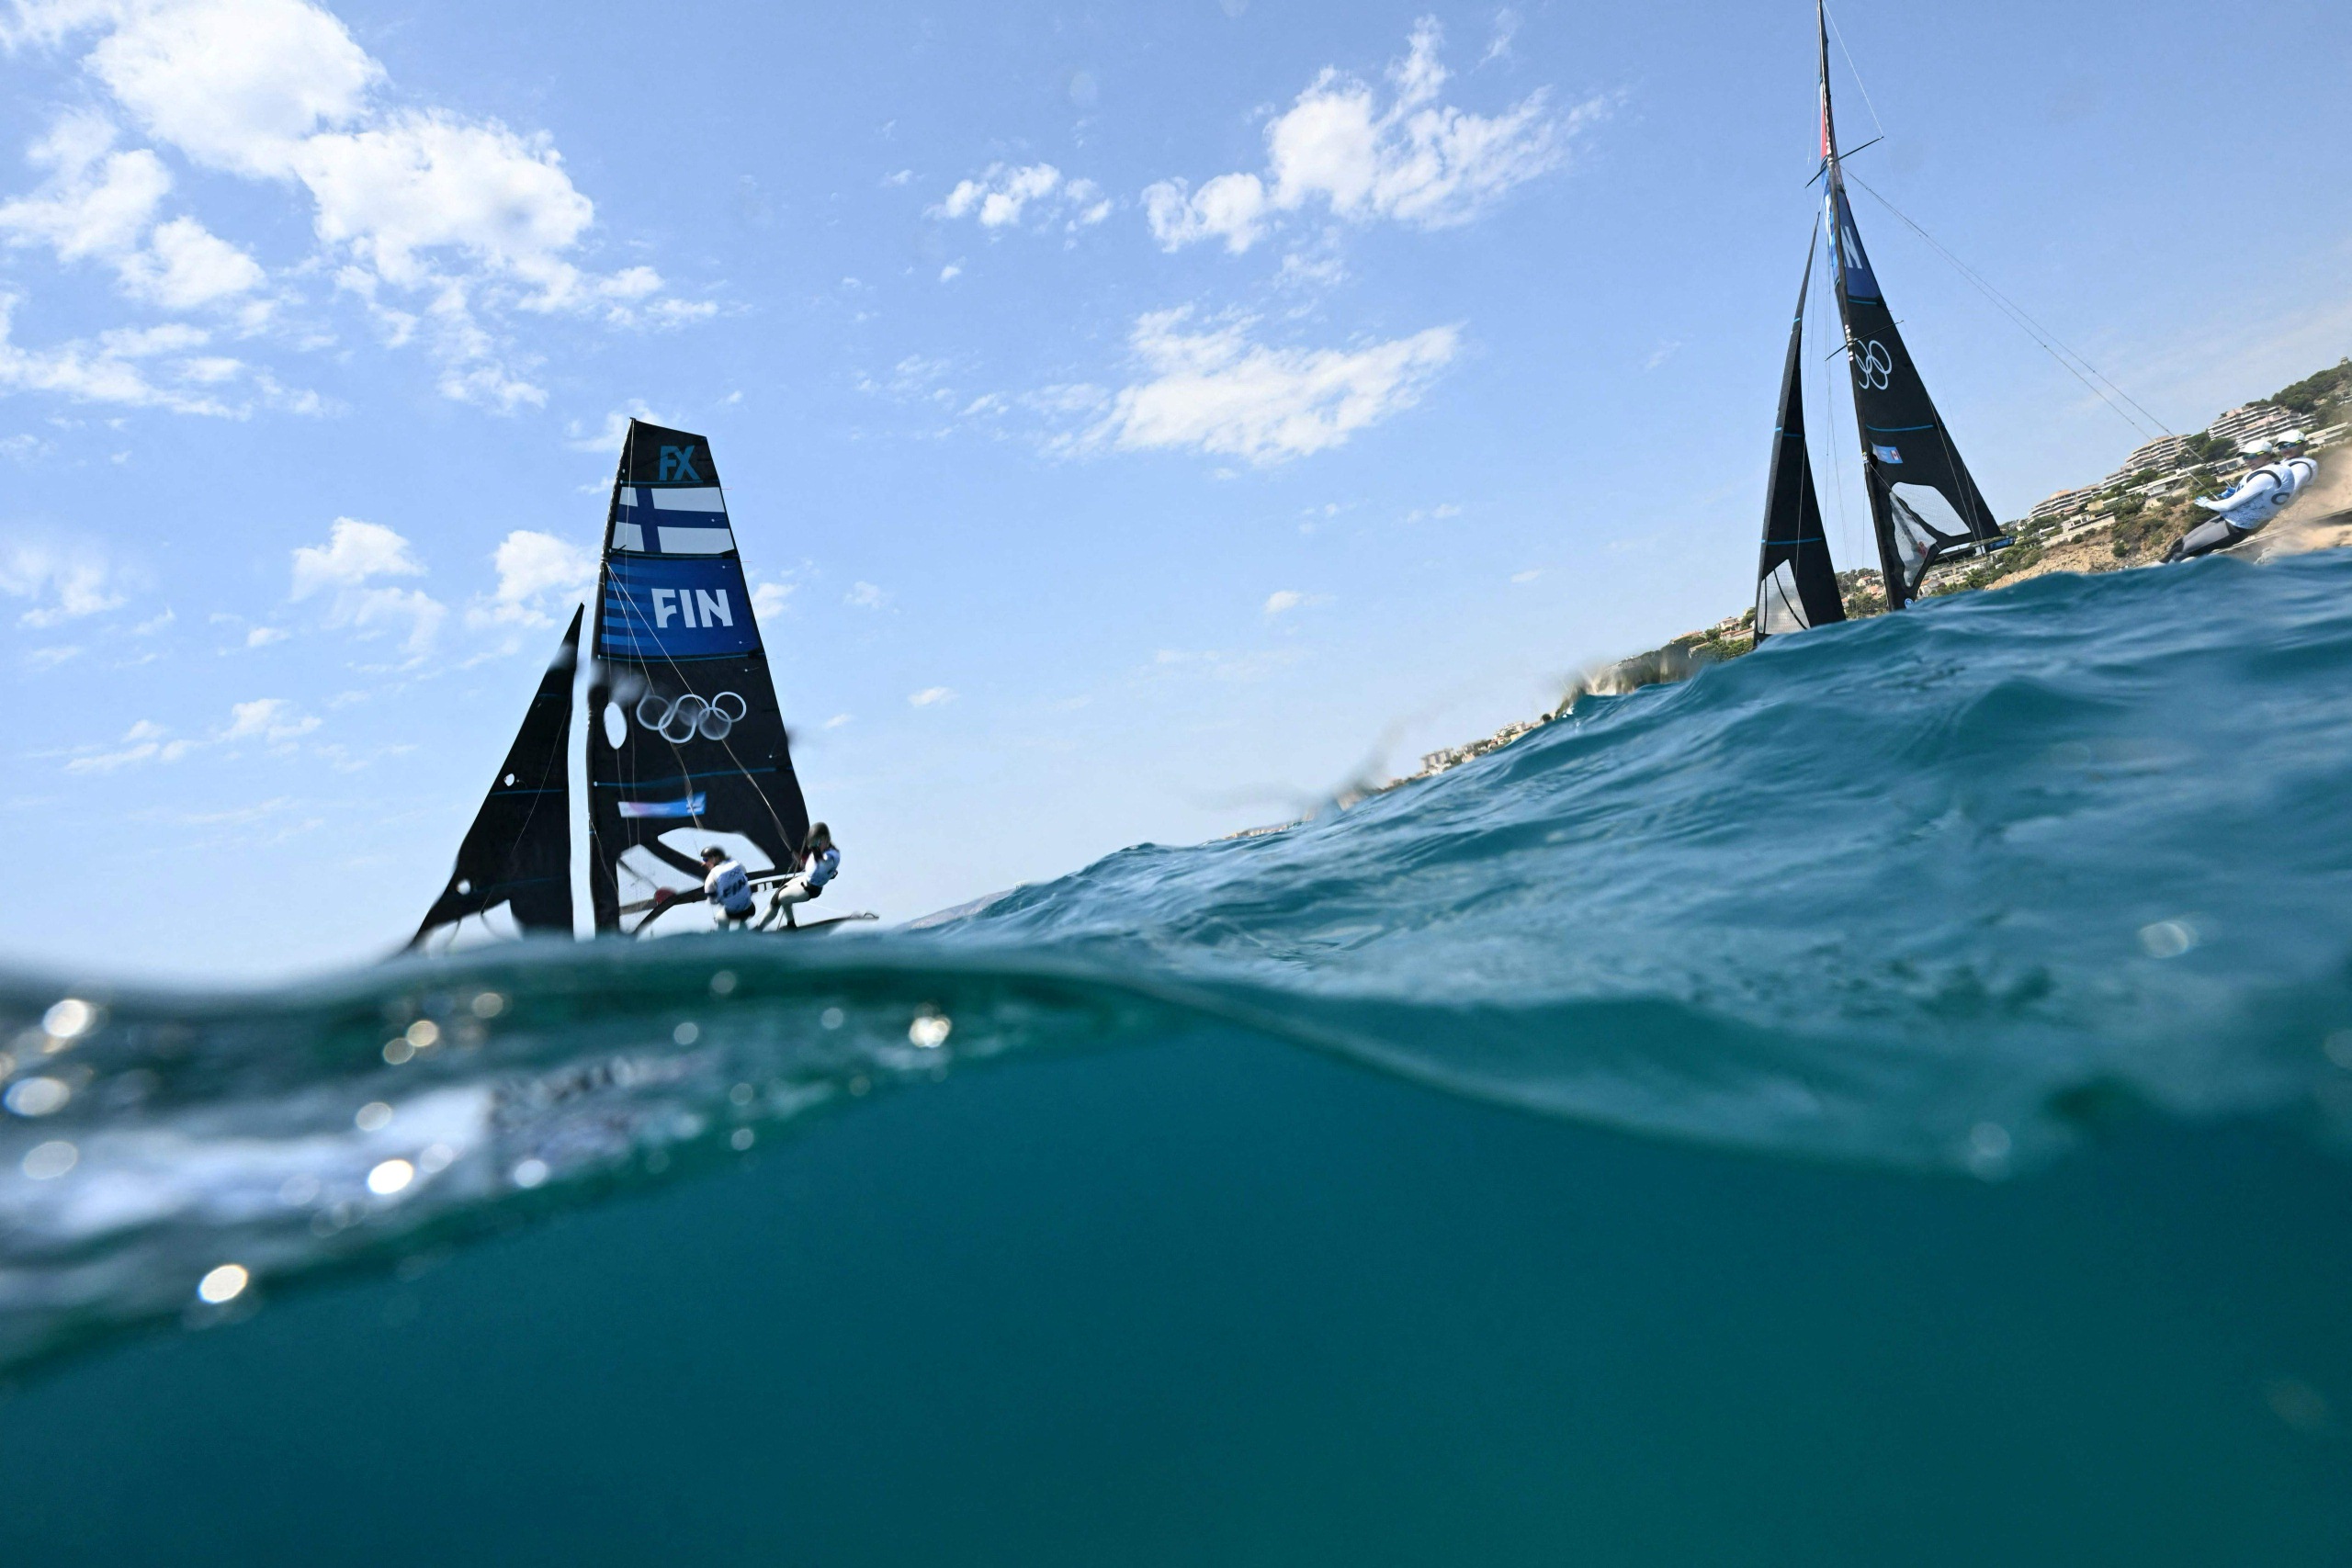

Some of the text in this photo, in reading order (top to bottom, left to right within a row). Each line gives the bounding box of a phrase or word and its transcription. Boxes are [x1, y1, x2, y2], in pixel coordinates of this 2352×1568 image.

[1840, 224, 1863, 269] N
[659, 445, 701, 481] FX
[651, 588, 734, 628] FIN
[723, 876, 747, 898] FIN
